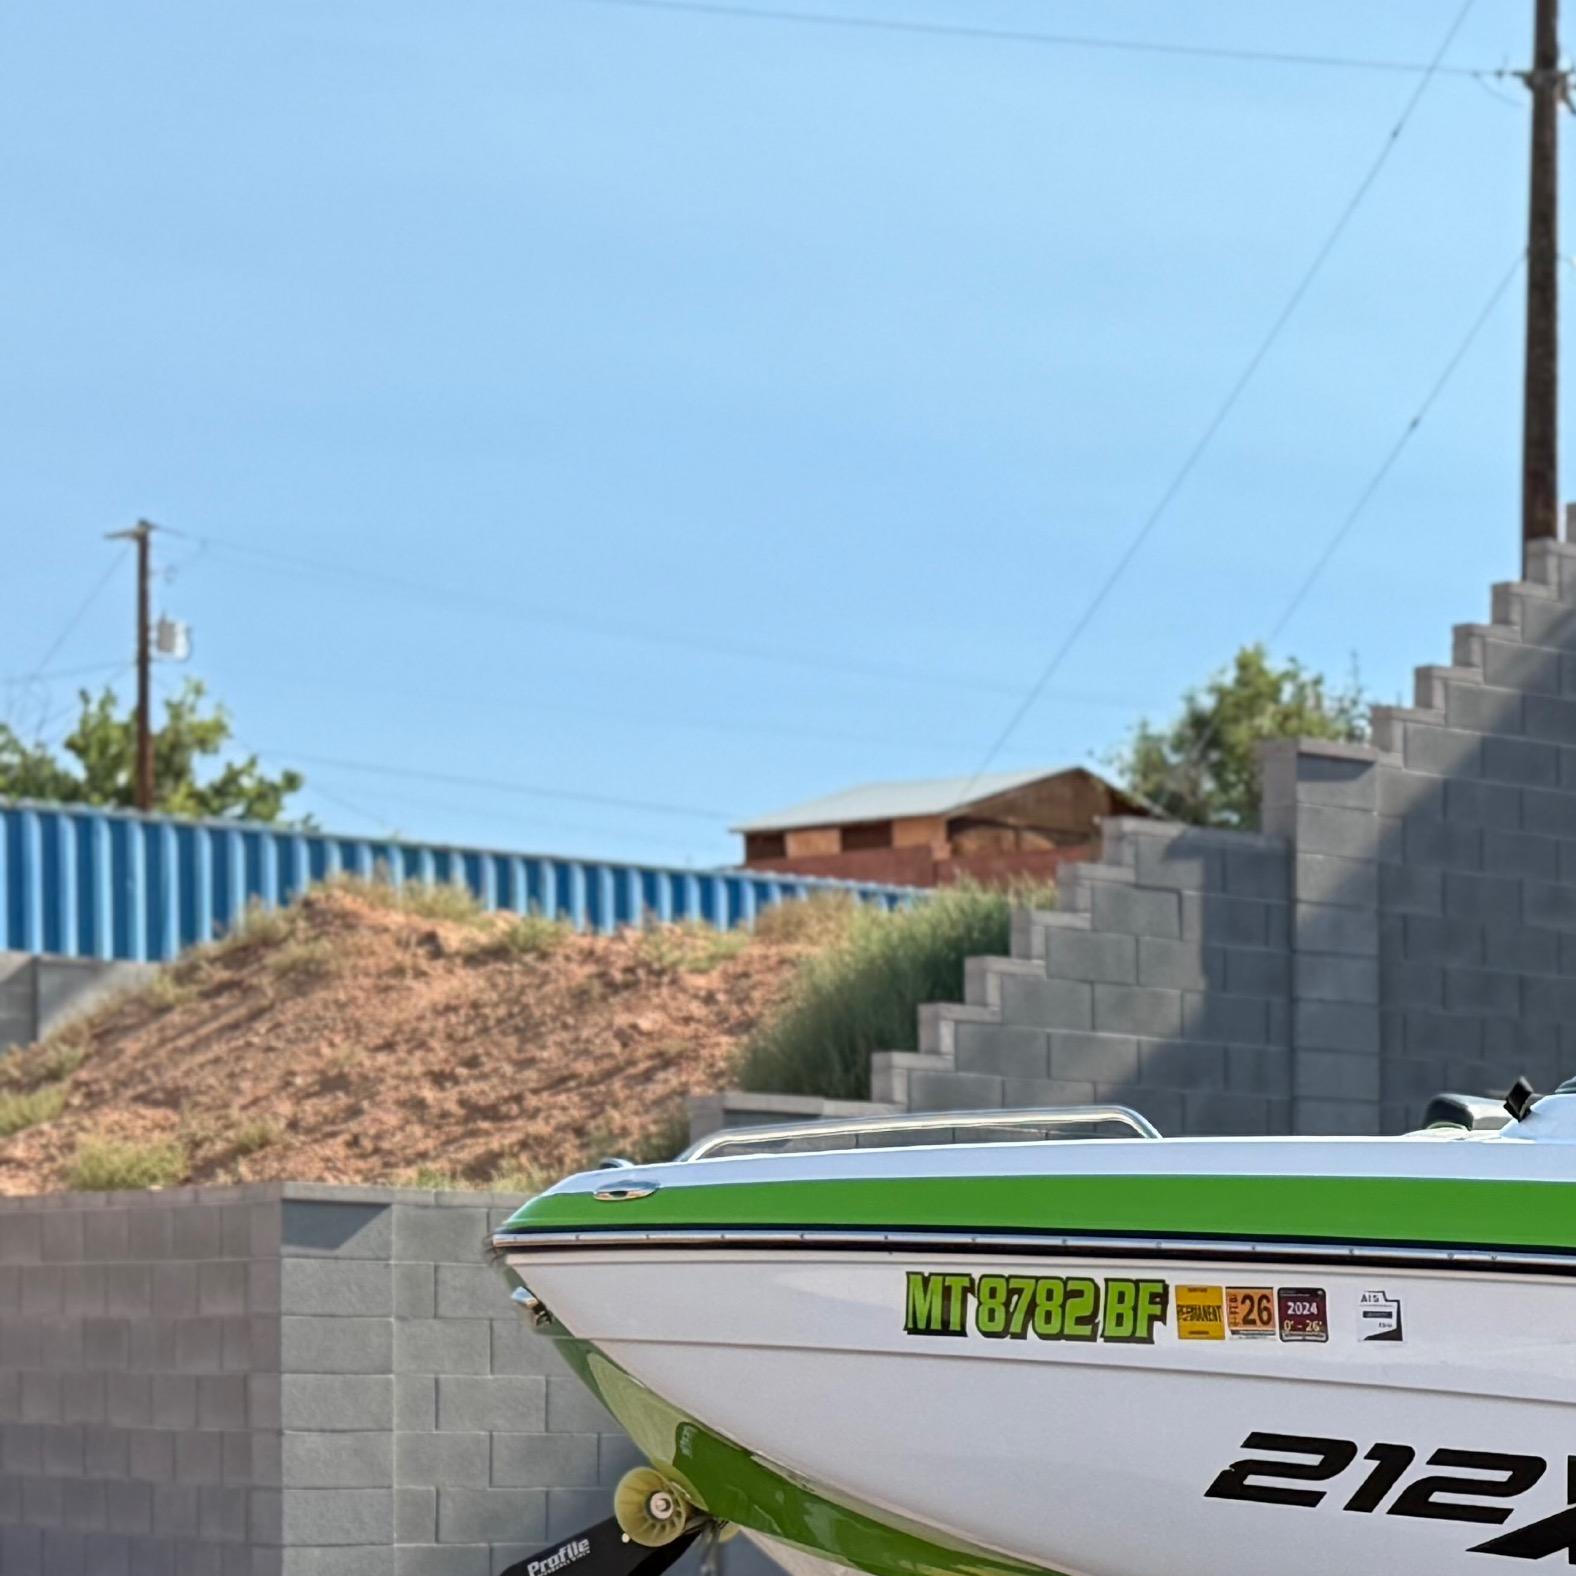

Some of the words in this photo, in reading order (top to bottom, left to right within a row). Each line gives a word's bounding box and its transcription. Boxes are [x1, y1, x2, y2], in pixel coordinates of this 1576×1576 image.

[904, 1271, 976, 1337] MT
[976, 1274, 1101, 1342] 8782
[1101, 1277, 1169, 1344] BF
[1241, 1294, 1272, 1326] 26
[1287, 1301, 1318, 1315] 2024
